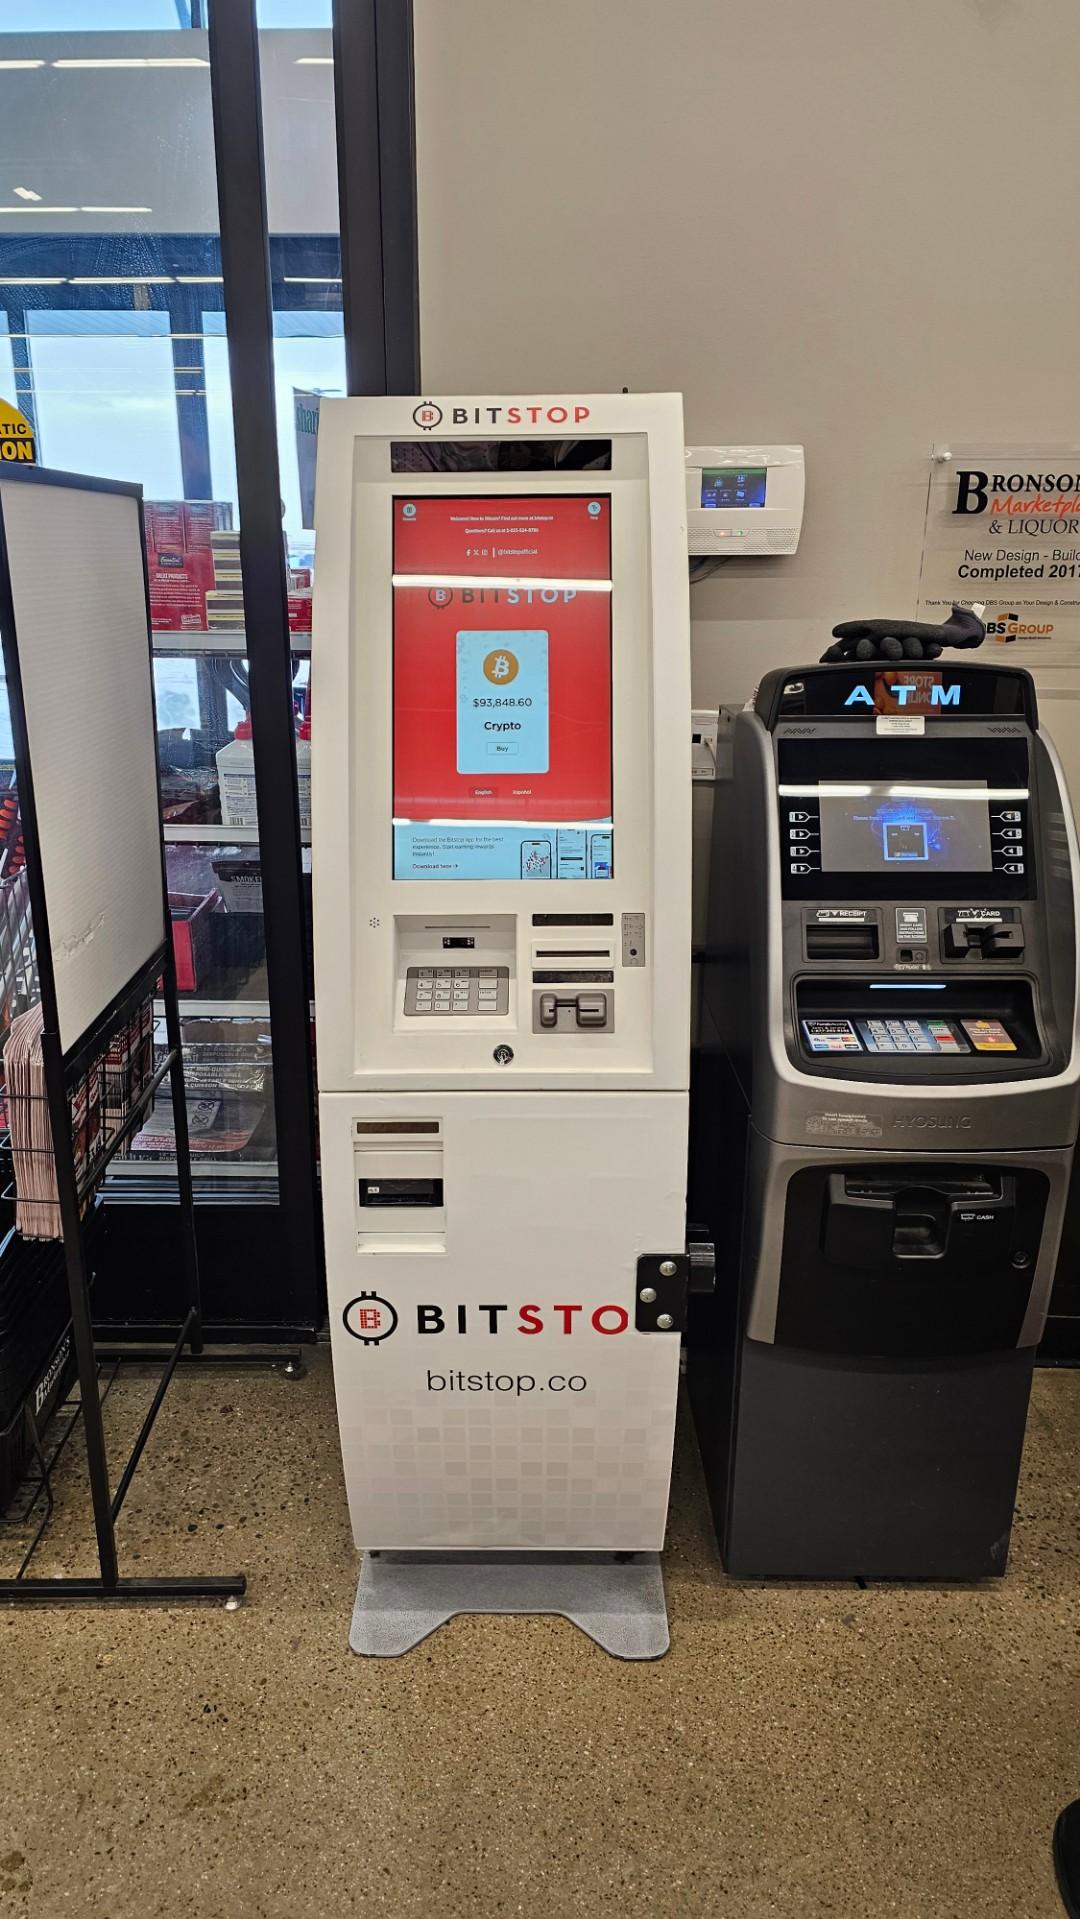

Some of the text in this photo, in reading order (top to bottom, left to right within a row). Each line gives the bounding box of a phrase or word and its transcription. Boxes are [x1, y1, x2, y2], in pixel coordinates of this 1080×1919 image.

[452, 407, 590, 424] BITSTOP
[0, 423, 27, 435] TIC
[0, 441, 33, 460] ON
[952, 470, 1080, 515] BRONSO
[989, 519, 1079, 537] & LIQUOR
[964, 550, 993, 561] New
[996, 550, 1040, 564] Design
[958, 564, 1080, 581] Completed 201
[984, 623, 1054, 634] BS GROUP
[473, 698, 532, 708] $93,848.60
[844, 685, 961, 705] ATM
[484, 721, 522, 732] Crypto
[230, 875, 262, 883] SMOKE
[417, 1304, 629, 1335] BITSTO
[427, 1370, 587, 1396] bitstop.co
